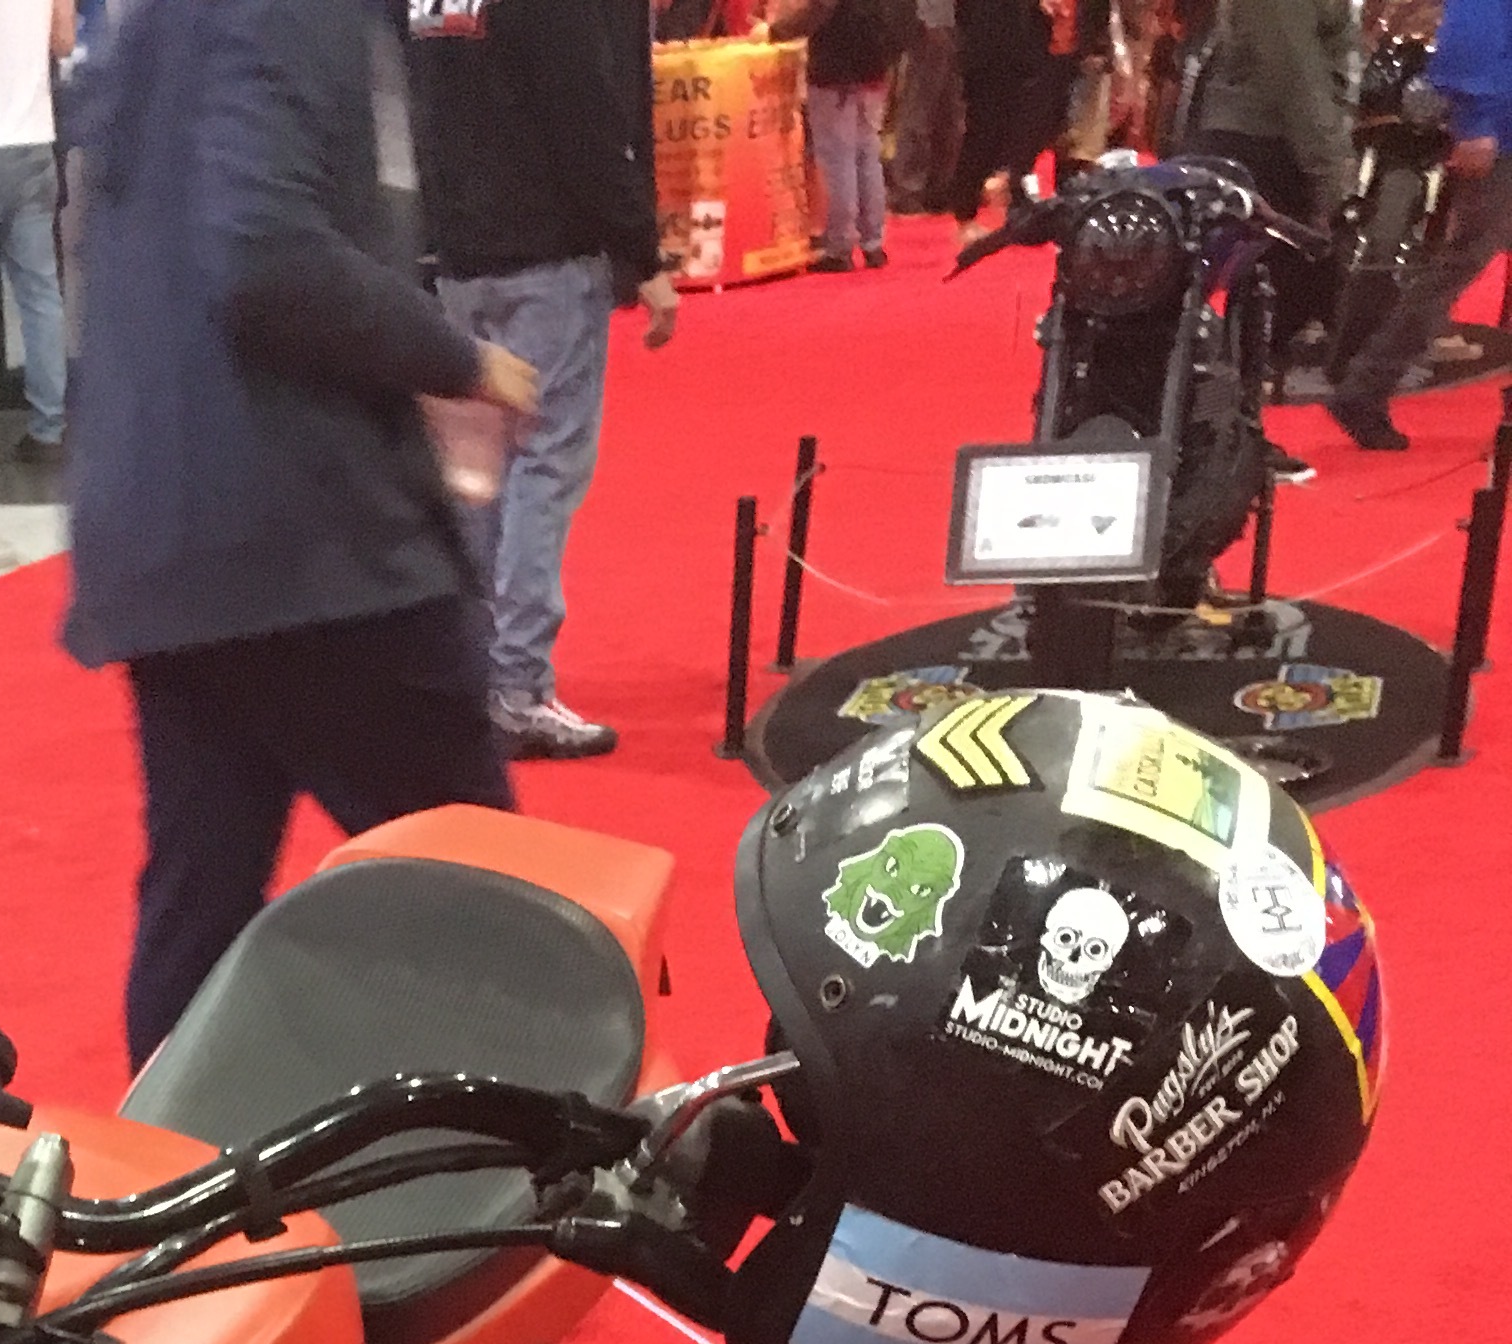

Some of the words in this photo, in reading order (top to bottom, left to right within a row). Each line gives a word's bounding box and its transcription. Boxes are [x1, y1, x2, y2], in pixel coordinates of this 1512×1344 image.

[950, 973, 1135, 1078] MIDNIGHT
[1014, 993, 1083, 1030] STUDIO
[1097, 1095, 1244, 1216] BARBER
[1235, 1014, 1302, 1106] SHOP
